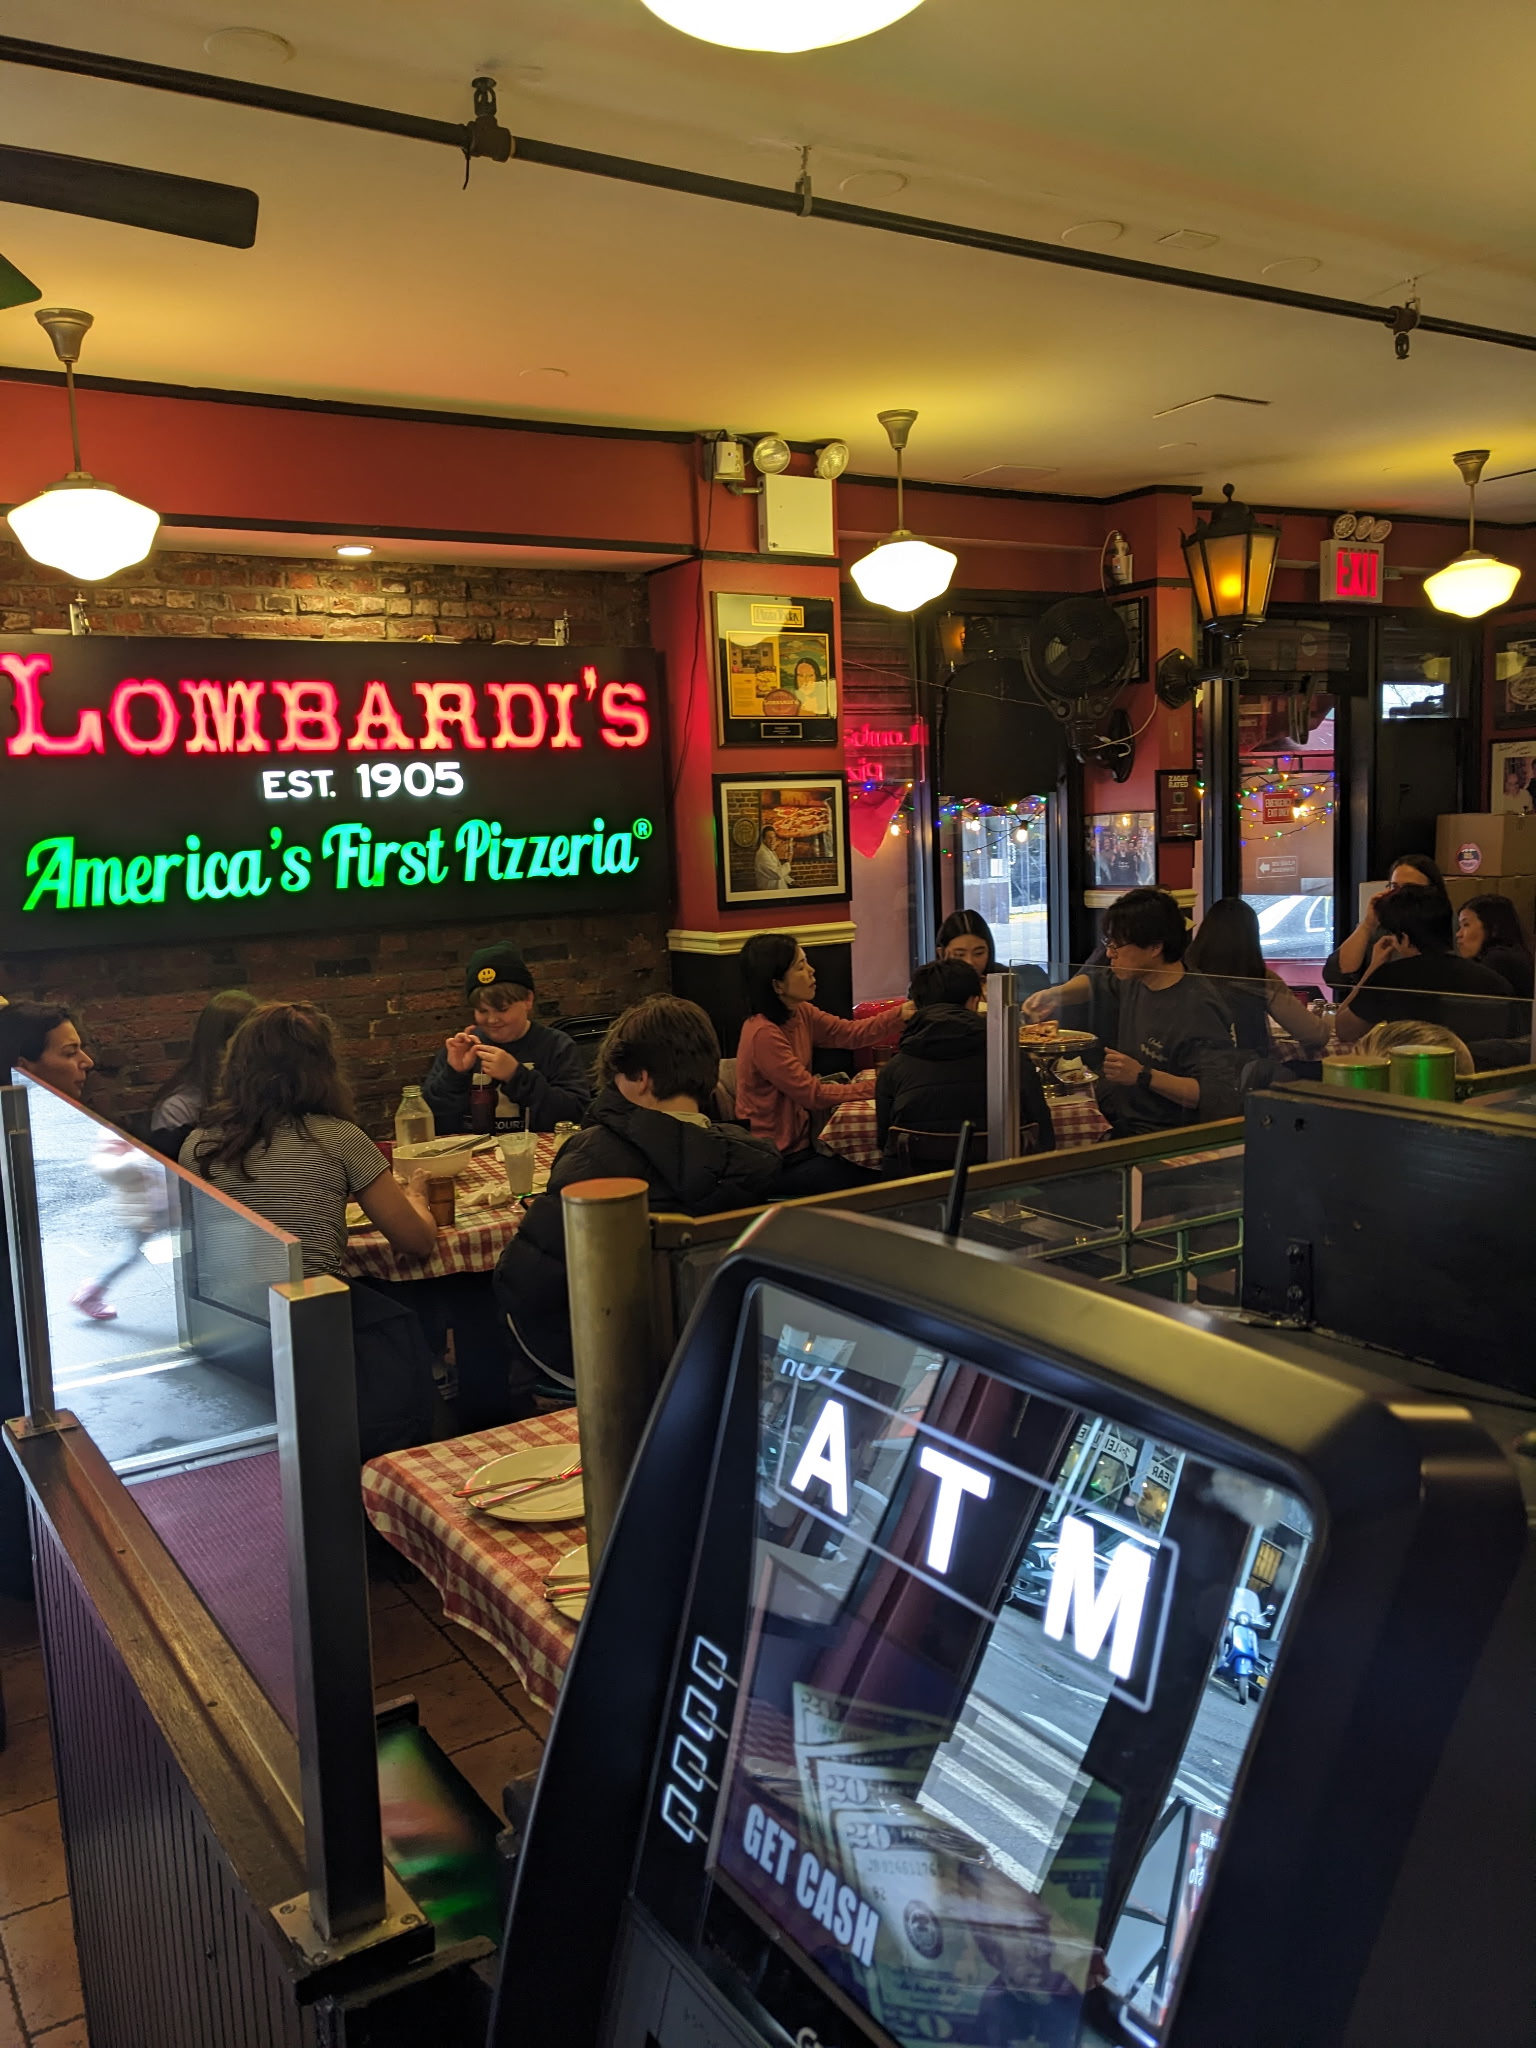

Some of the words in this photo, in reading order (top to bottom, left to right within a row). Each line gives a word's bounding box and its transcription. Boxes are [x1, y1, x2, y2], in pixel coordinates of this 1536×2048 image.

[1337, 548, 1379, 597] EXIT
[0, 653, 650, 756] LOMBARDI'S
[262, 769, 336, 799] EST.
[356, 761, 464, 798] 1905
[22, 826, 312, 910] America's
[322, 822, 449, 889] First
[790, 1398, 1152, 1681] ATM
[743, 1803, 797, 1886] GET
[796, 1852, 879, 1968] CASH
